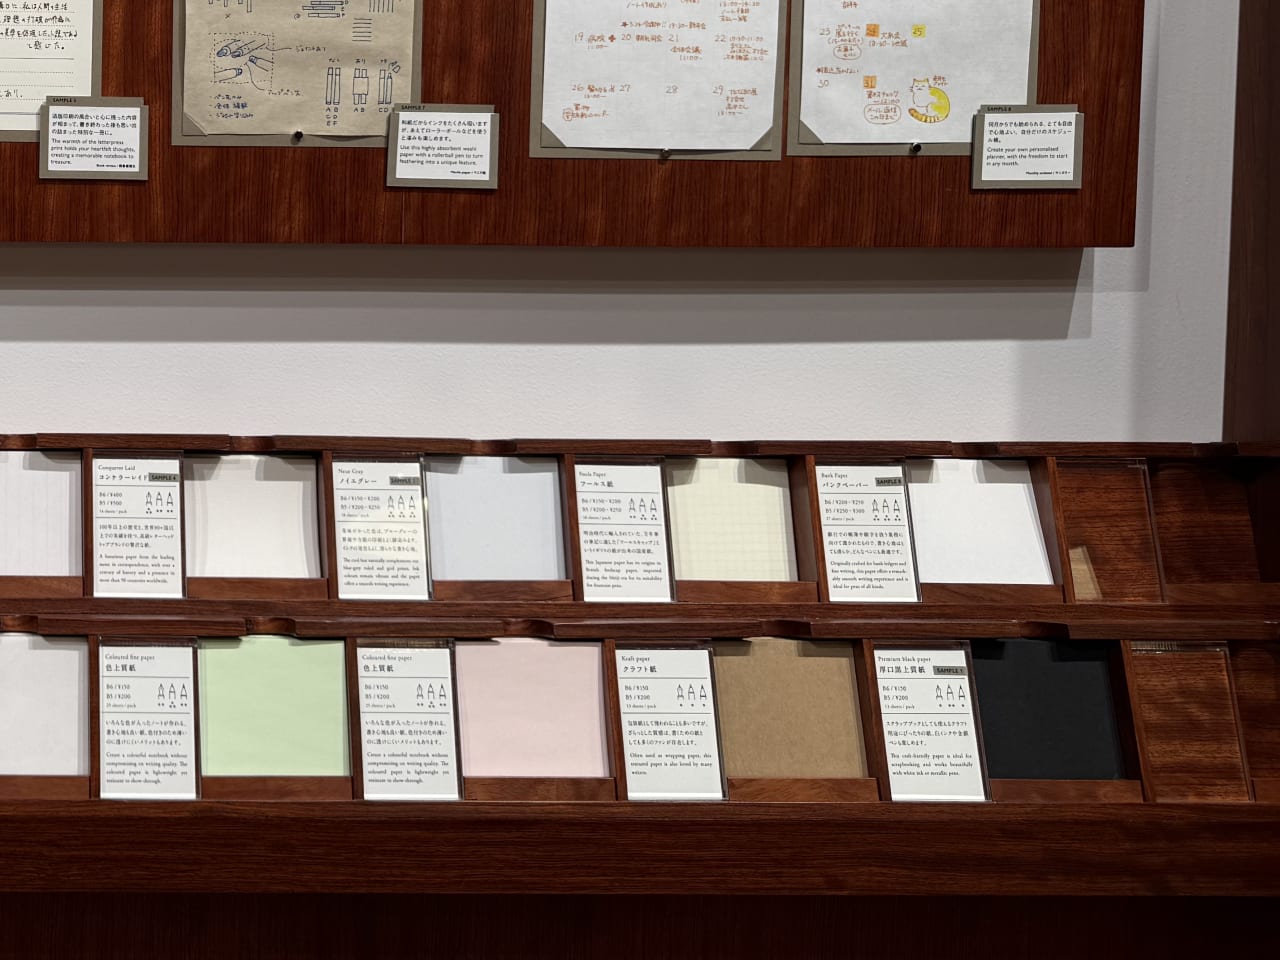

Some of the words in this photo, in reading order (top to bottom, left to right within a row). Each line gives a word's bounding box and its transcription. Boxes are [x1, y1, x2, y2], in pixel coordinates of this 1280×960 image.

[621, 34, 632, 42] 20
[668, 34, 680, 42] 21
[619, 84, 631, 93] 27
[666, 86, 679, 94] 28
[712, 85, 723, 95] 29
[106, 664, 136, 672] 色上質紙
[623, 665, 657, 673] クラフト紙
